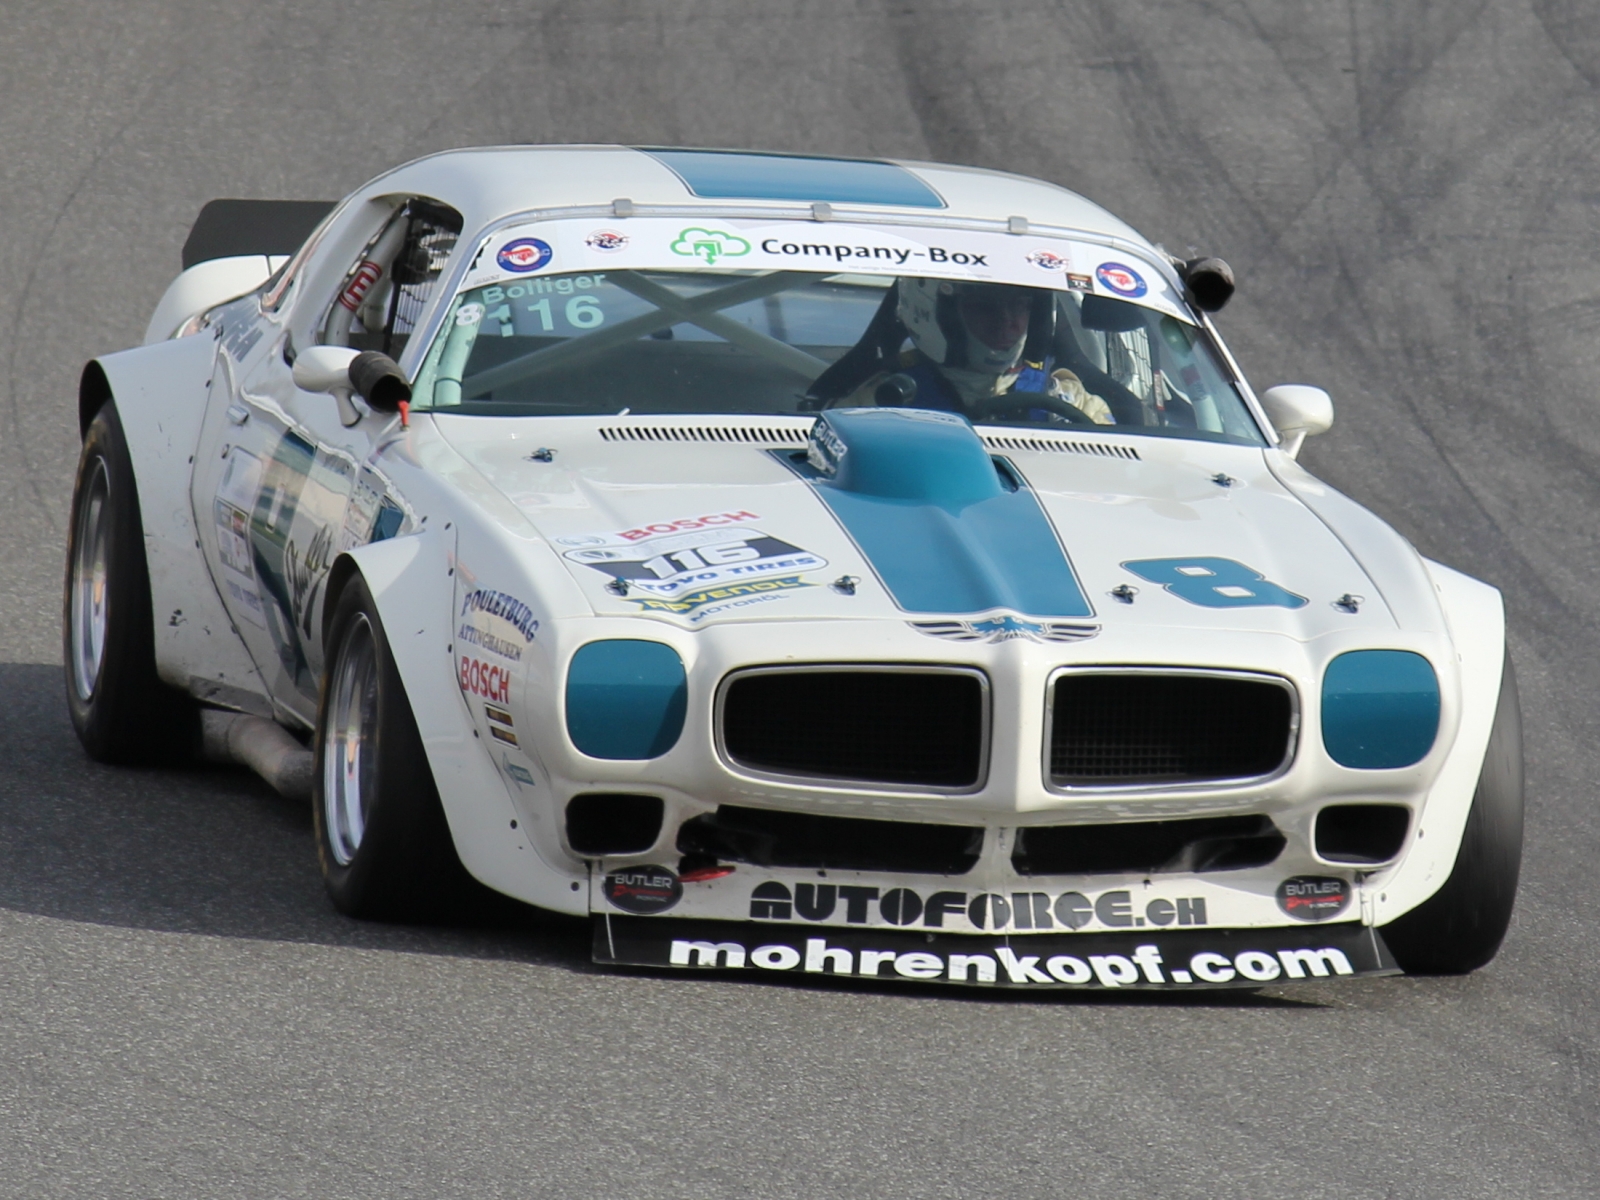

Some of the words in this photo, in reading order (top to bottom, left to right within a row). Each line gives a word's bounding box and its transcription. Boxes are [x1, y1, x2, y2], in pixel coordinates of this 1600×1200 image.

[761, 238, 990, 267] Company-Box
[482, 273, 606, 305] Bolliger
[487, 295, 605, 338] 116
[615, 510, 760, 541] BOSCH
[642, 540, 760, 580] 116
[726, 556, 817, 575] TIRES
[460, 588, 540, 643] POULETBURG
[458, 622, 523, 662] ATTINGHAUSEN
[460, 655, 510, 705] BOSCH
[614, 874, 673, 889] BUTLER
[1285, 881, 1341, 896] BUTLER
[669, 938, 1354, 988] mohrenkopf.com
